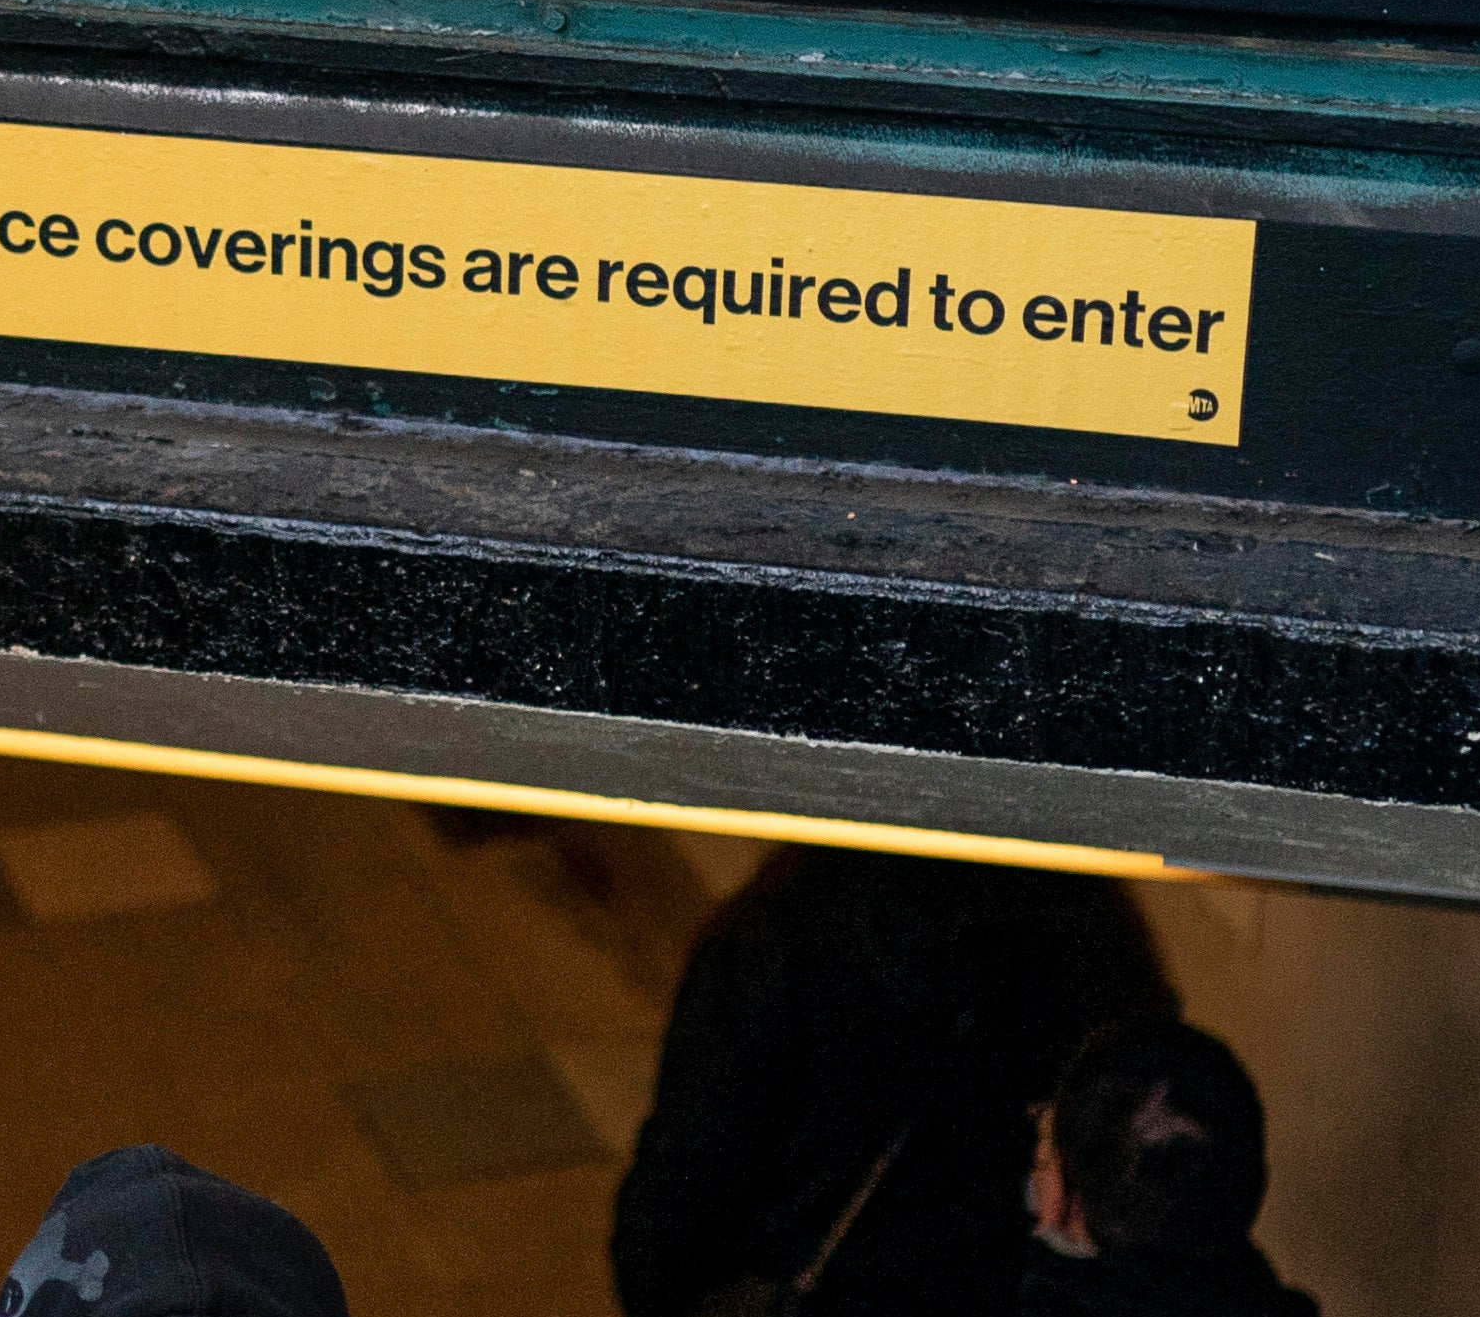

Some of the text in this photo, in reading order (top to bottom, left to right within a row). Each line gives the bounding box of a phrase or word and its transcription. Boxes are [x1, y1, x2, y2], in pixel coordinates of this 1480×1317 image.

[95, 218, 446, 298] coverings
[462, 248, 579, 301] are
[597, 257, 911, 328] required
[928, 273, 1006, 336] to
[1022, 290, 1225, 354] enter
